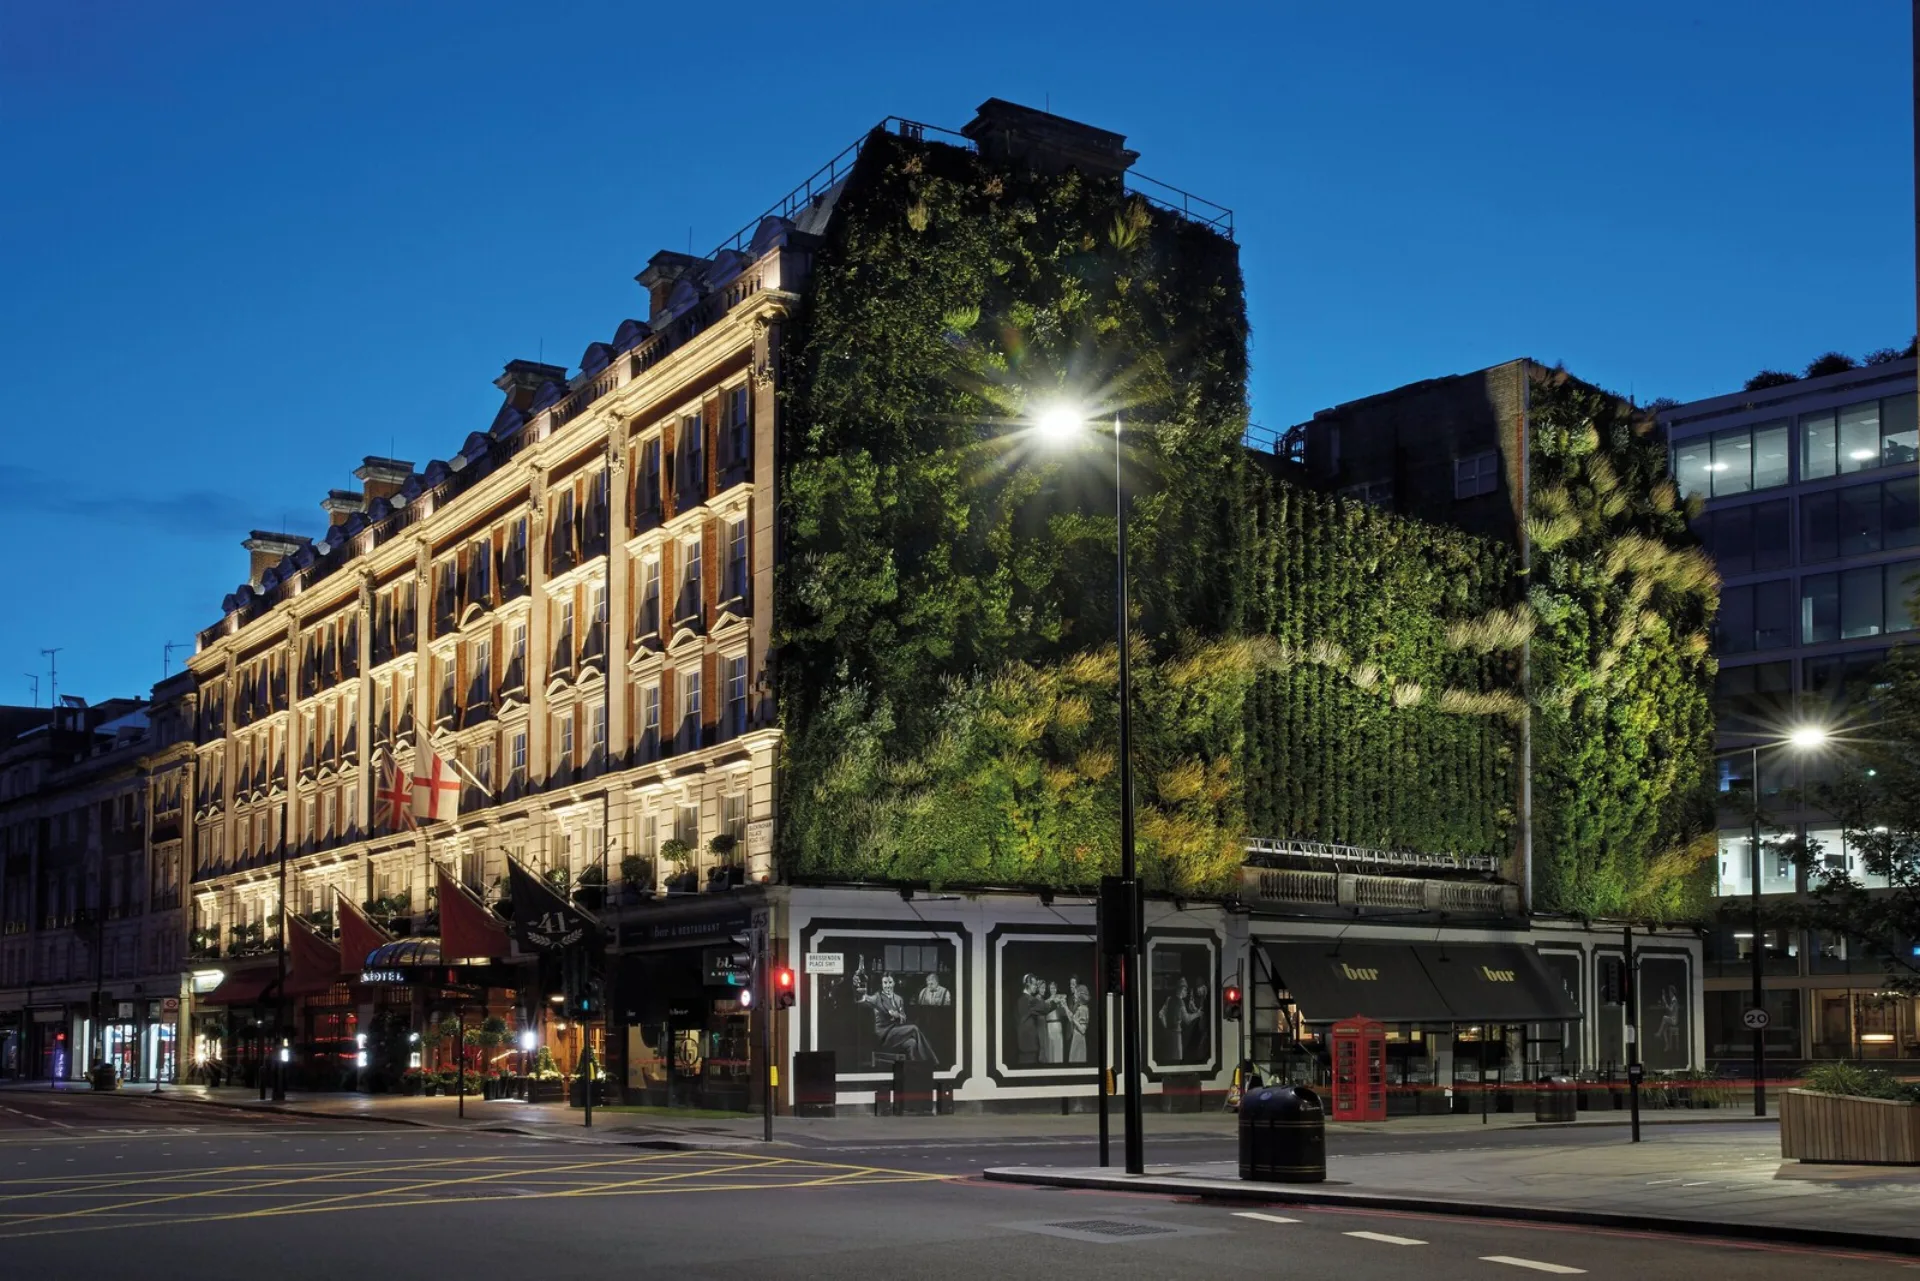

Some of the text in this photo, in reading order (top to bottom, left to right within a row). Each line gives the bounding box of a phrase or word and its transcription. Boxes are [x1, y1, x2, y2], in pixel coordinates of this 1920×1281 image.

[537, 911, 570, 934] 41
[678, 922, 720, 936] RESTAURANT
[1746, 1013, 1767, 1024] 20
